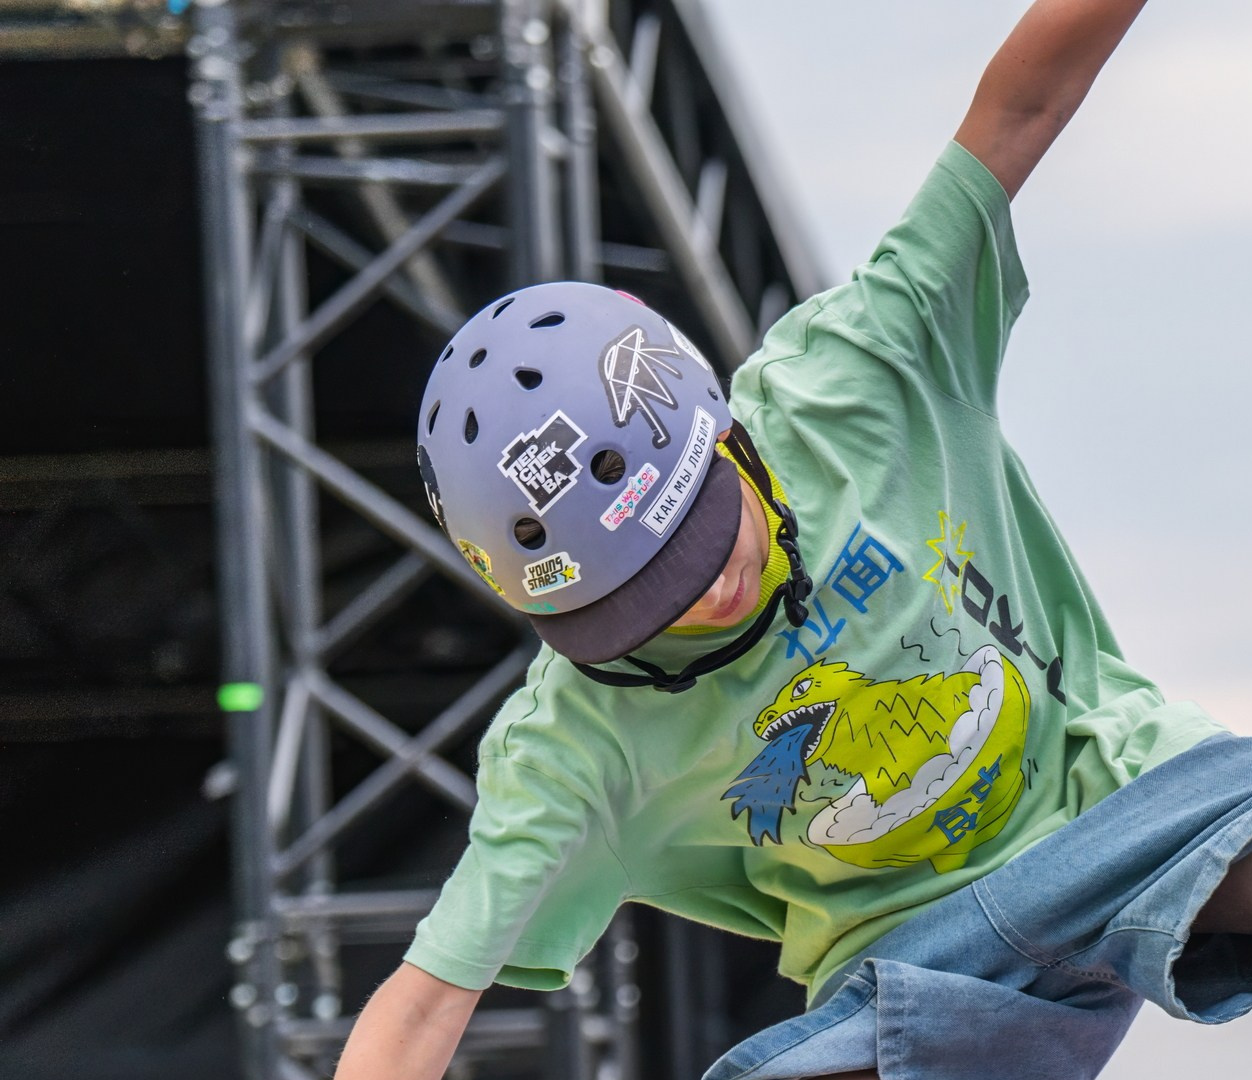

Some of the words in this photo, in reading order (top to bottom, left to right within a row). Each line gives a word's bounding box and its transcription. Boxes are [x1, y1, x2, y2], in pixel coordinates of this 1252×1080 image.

[507, 444, 539, 476] ПЕР
[519, 440, 563, 482] СПЕК
[652, 494, 678, 524] КАК
[673, 468, 693, 494] МЫ
[689, 417, 711, 468] ЛЮБИМ
[526, 466, 552, 490] ТИ
[541, 470, 568, 494] ВА
[604, 503, 623, 523] THIS
[637, 466, 653, 485] FOR
[613, 499, 634, 526] GOOD
[633, 474, 655, 502] STUFF
[527, 572, 558, 590] STARS
[528, 556, 563, 578] YOUNG
